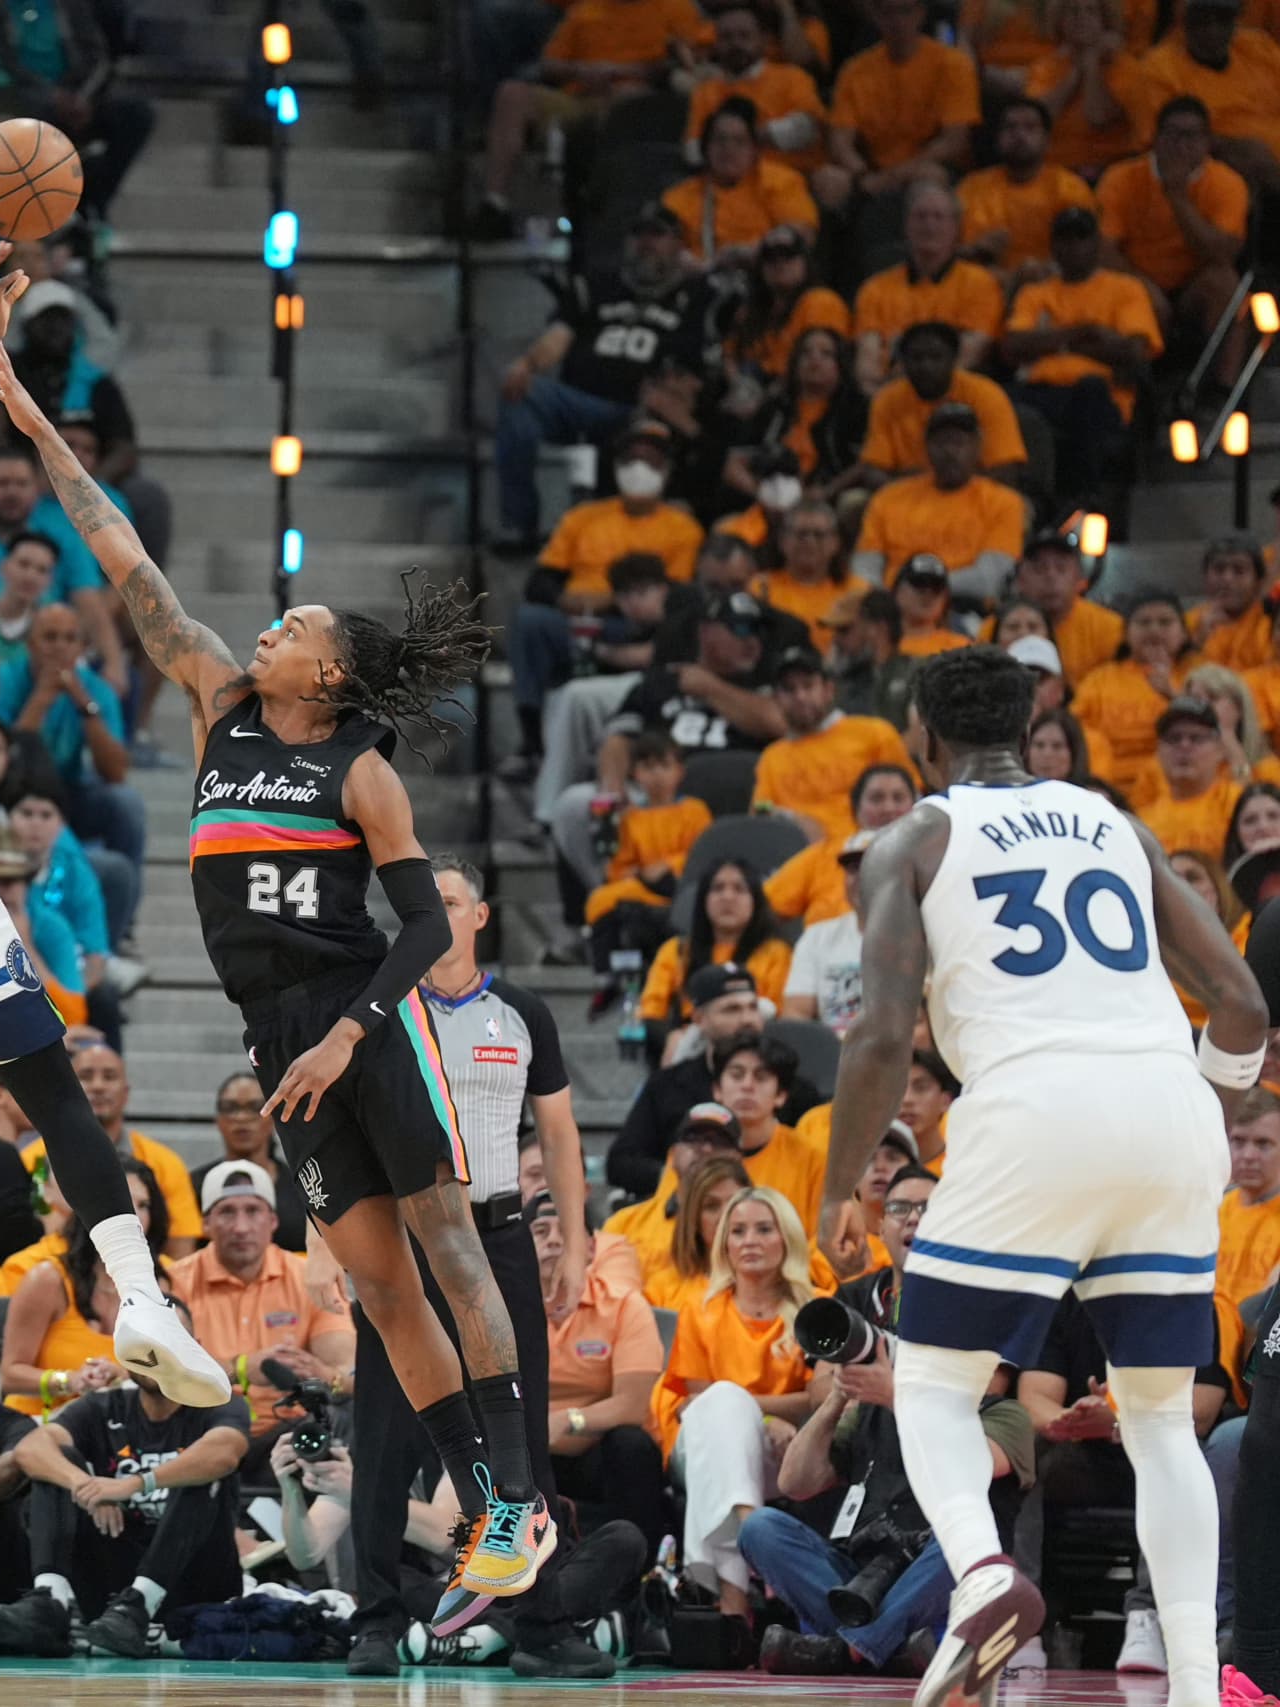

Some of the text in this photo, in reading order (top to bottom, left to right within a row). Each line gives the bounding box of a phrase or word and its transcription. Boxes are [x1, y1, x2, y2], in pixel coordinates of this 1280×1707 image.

[198, 769, 320, 808] San Antonio
[979, 811, 1113, 853] RANDLE
[247, 861, 320, 919] 24
[972, 868, 1150, 977] 30
[473, 1047, 518, 1063] Emirates
